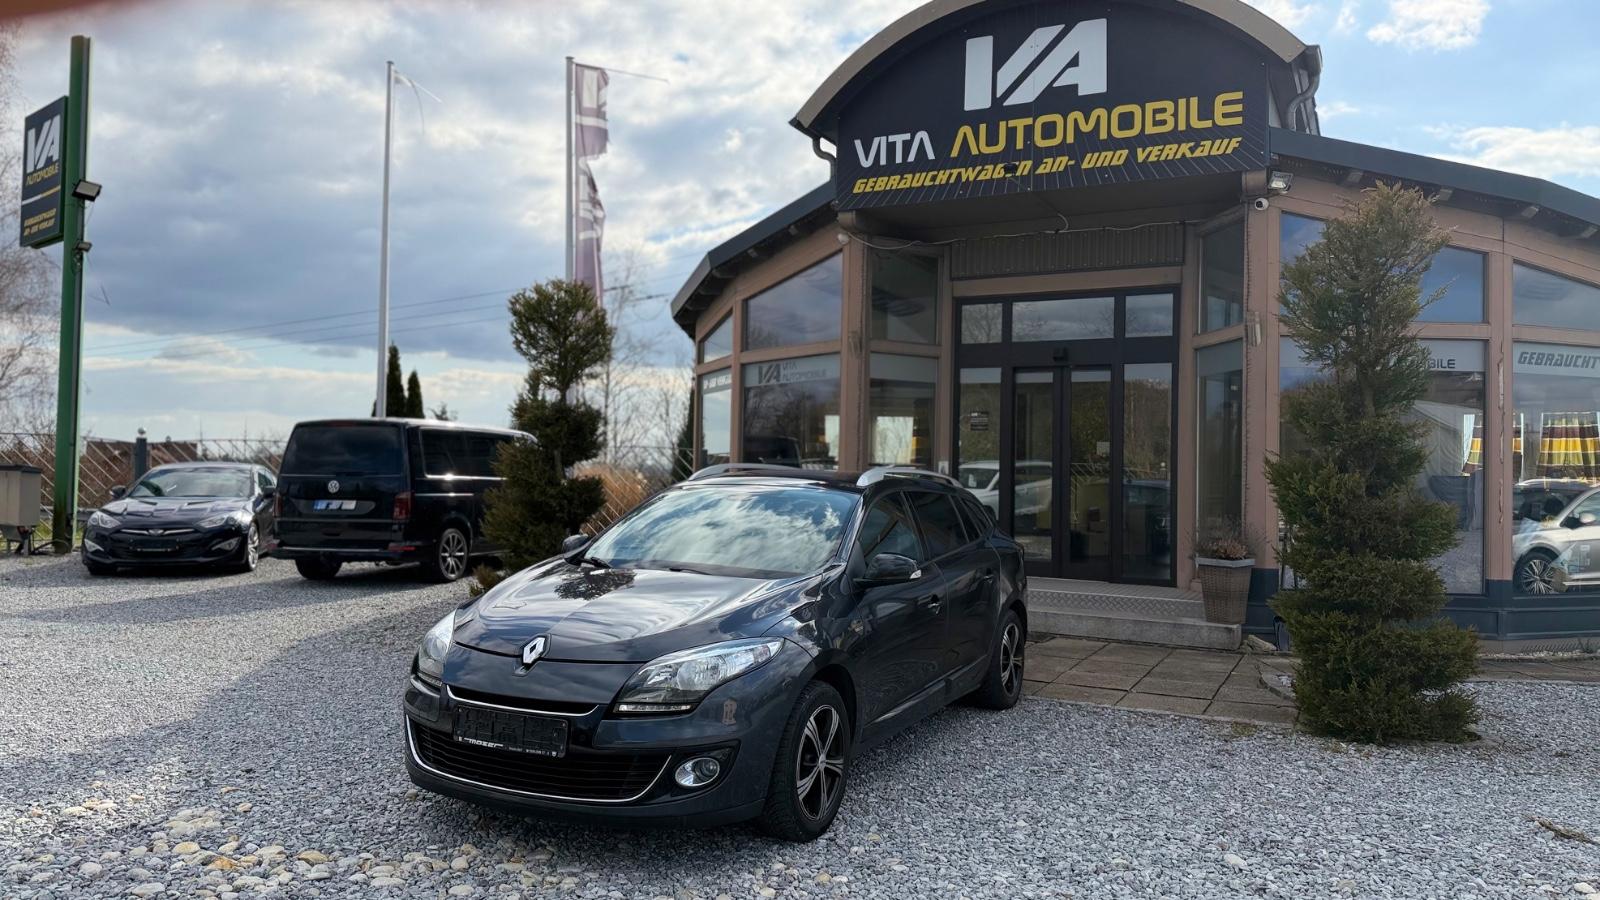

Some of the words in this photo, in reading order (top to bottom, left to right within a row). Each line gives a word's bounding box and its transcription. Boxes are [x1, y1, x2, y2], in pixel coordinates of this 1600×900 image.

[854, 131, 936, 168] VITA
[951, 91, 1244, 158] AUTOMOBILE
[26, 162, 60, 187] AUTOMOBILE
[852, 160, 1033, 194] GEBRAUCHTWAGN
[1081, 149, 1129, 169] UND
[1136, 137, 1243, 163] VERKAUF
[1427, 358, 1456, 369] BILE
